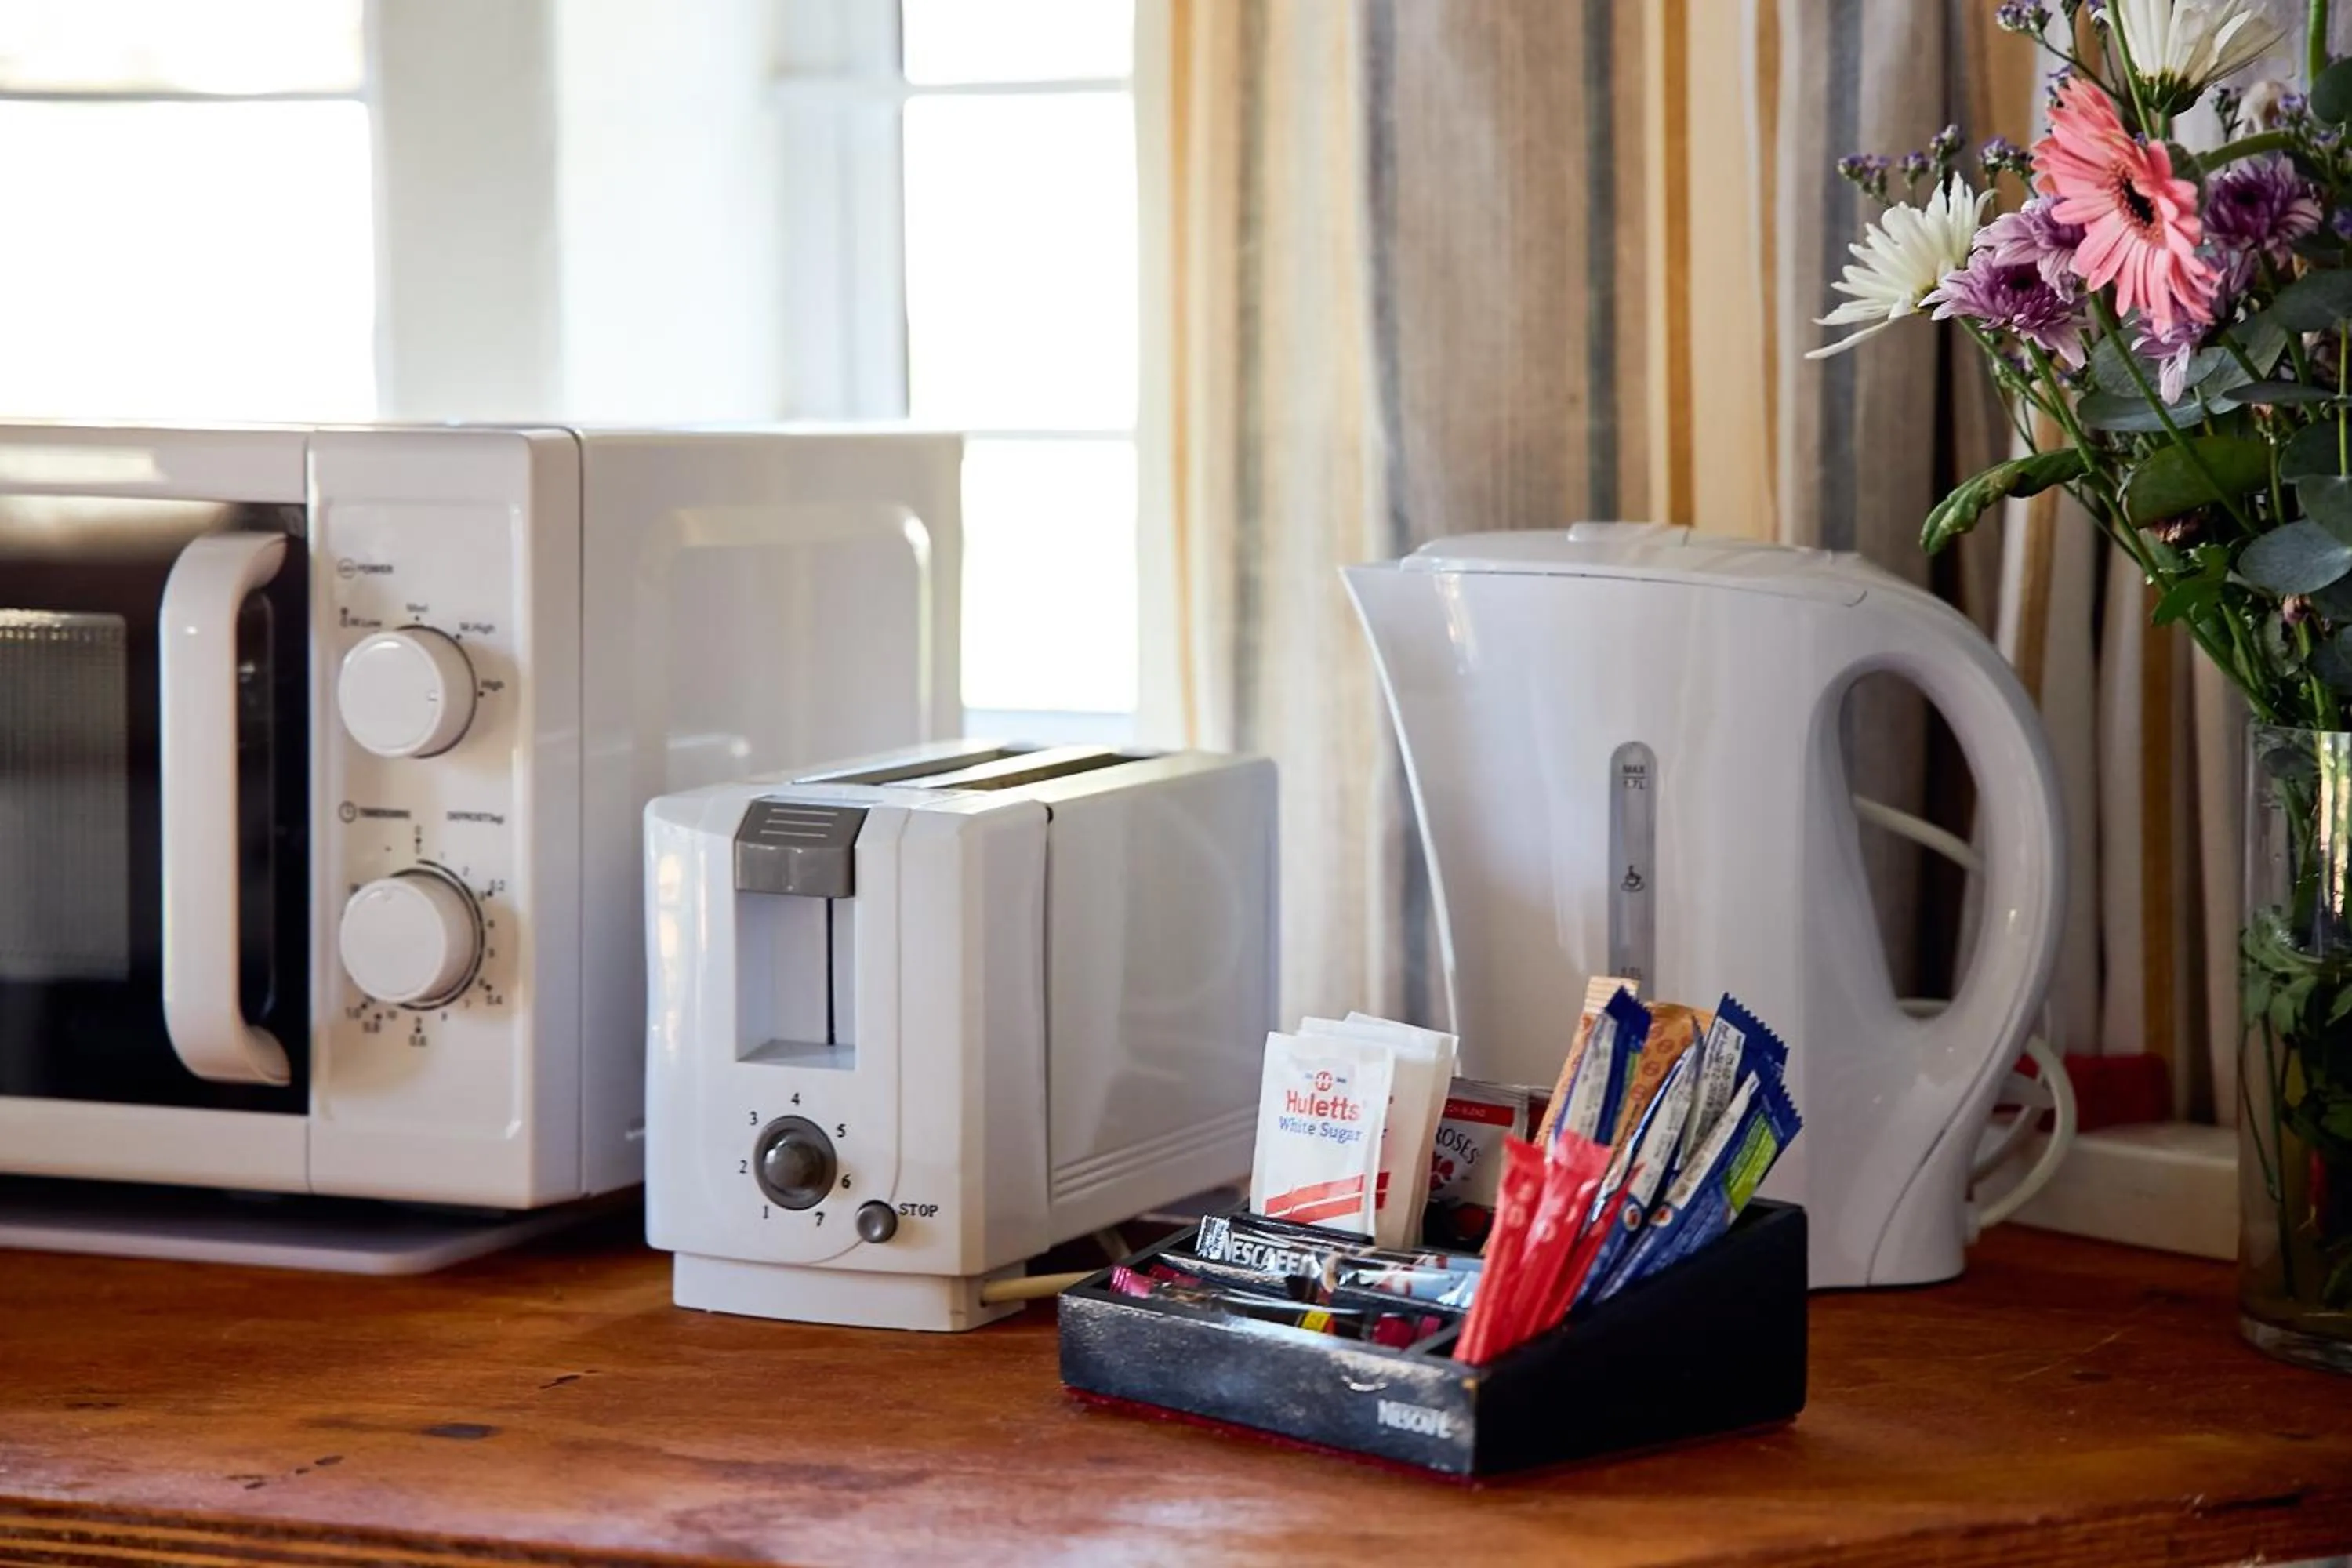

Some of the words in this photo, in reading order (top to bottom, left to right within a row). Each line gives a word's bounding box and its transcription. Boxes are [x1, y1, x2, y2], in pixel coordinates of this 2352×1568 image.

[791, 1092, 800, 1105] 4
[1286, 1089, 1361, 1121] Huletts
[750, 1111, 758, 1125] 3
[837, 1123, 846, 1138] 5
[1279, 1116, 1316, 1134] White
[1319, 1122, 1363, 1144] Sugar
[739, 1160, 748, 1174] 2
[840, 1174, 851, 1189] 6
[763, 1205, 769, 1219] 1
[898, 1203, 939, 1217] STOP
[815, 1211, 825, 1226] 7
